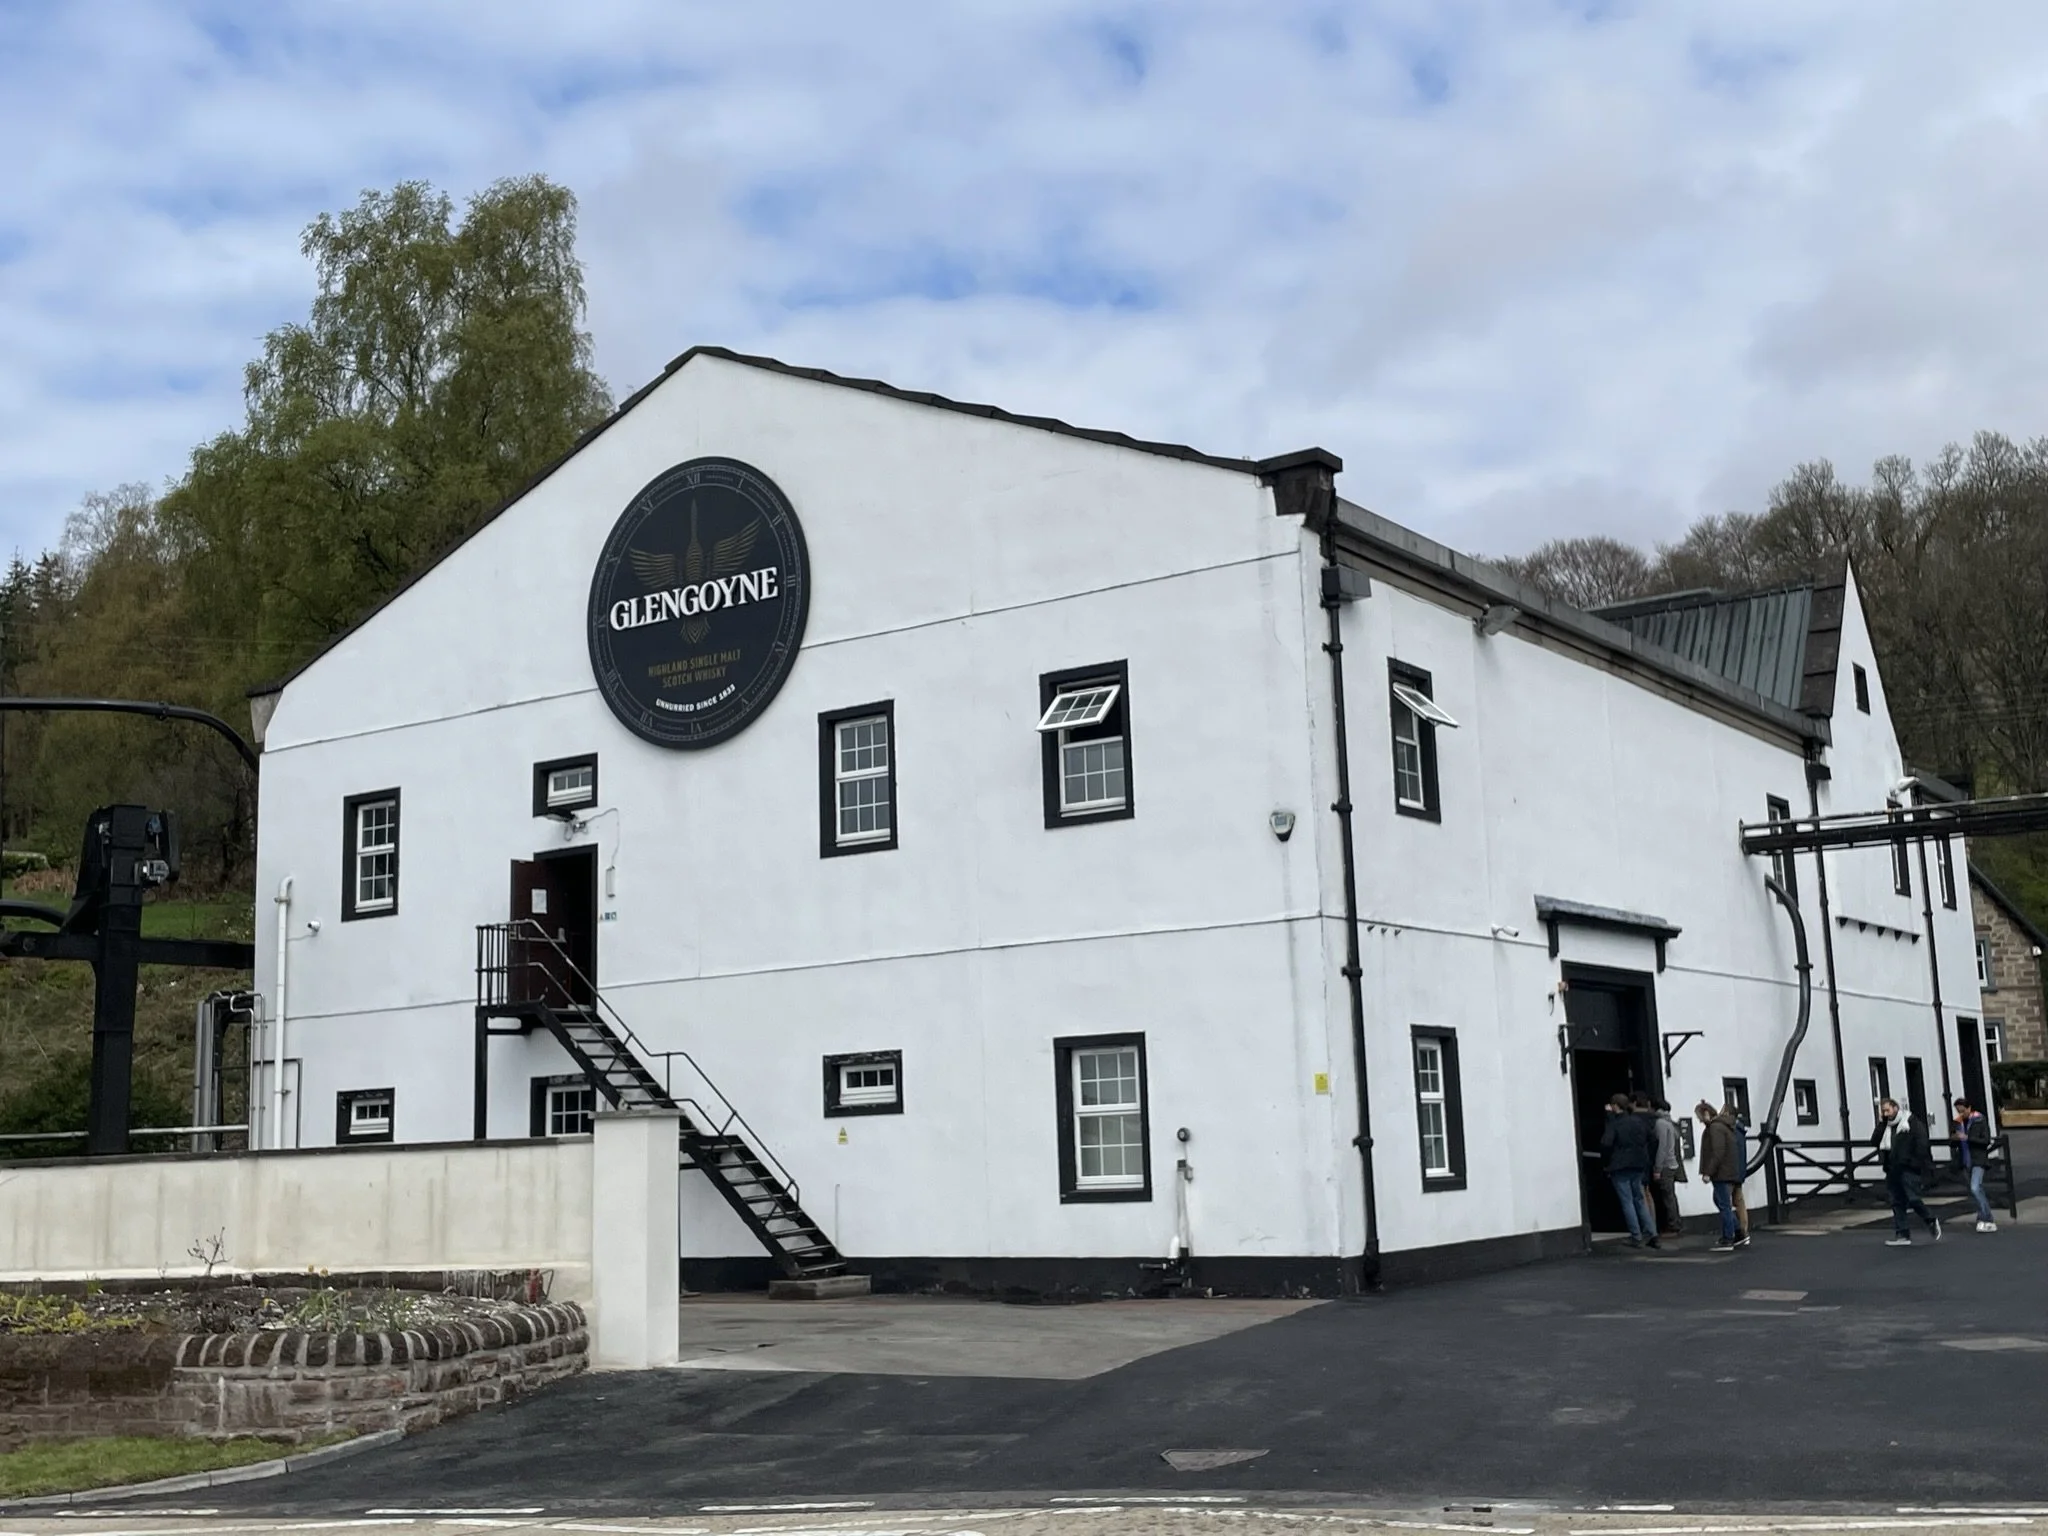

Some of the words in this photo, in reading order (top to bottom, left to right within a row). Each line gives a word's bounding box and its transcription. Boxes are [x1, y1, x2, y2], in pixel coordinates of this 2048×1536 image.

[609, 566, 779, 631] GLENGOYNE
[648, 661, 688, 677] HIGHLAND
[690, 653, 718, 669] SINGLE
[721, 649, 741, 663] MALT
[662, 671, 693, 688] SCOTCH
[695, 666, 726, 681] WHISKY
[656, 698, 694, 712] UNHURRIED
[696, 696, 718, 710] SINCE
[719, 684, 736, 701] 1833
